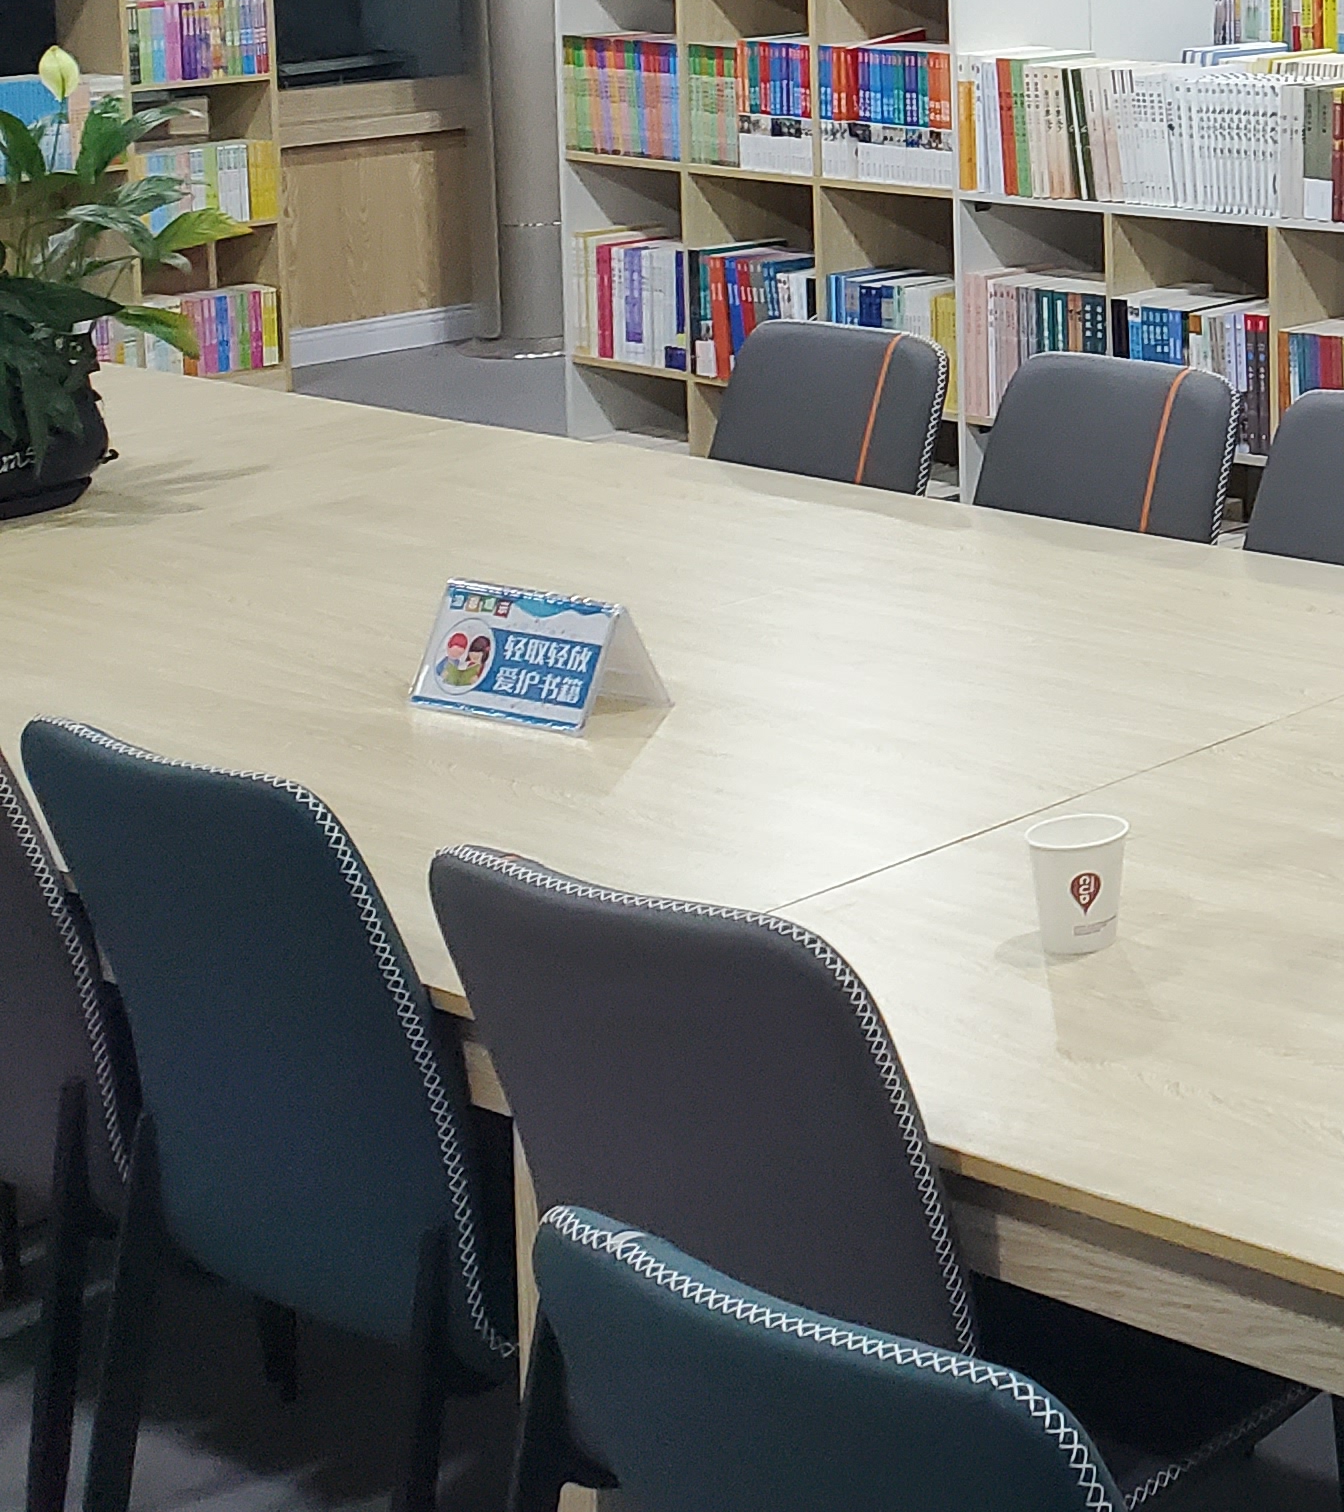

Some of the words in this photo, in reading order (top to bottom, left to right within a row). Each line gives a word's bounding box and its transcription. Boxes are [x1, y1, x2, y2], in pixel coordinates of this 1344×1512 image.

[503, 634, 593, 673] 轻取轻放
[492, 666, 584, 705] 爱护书籍
